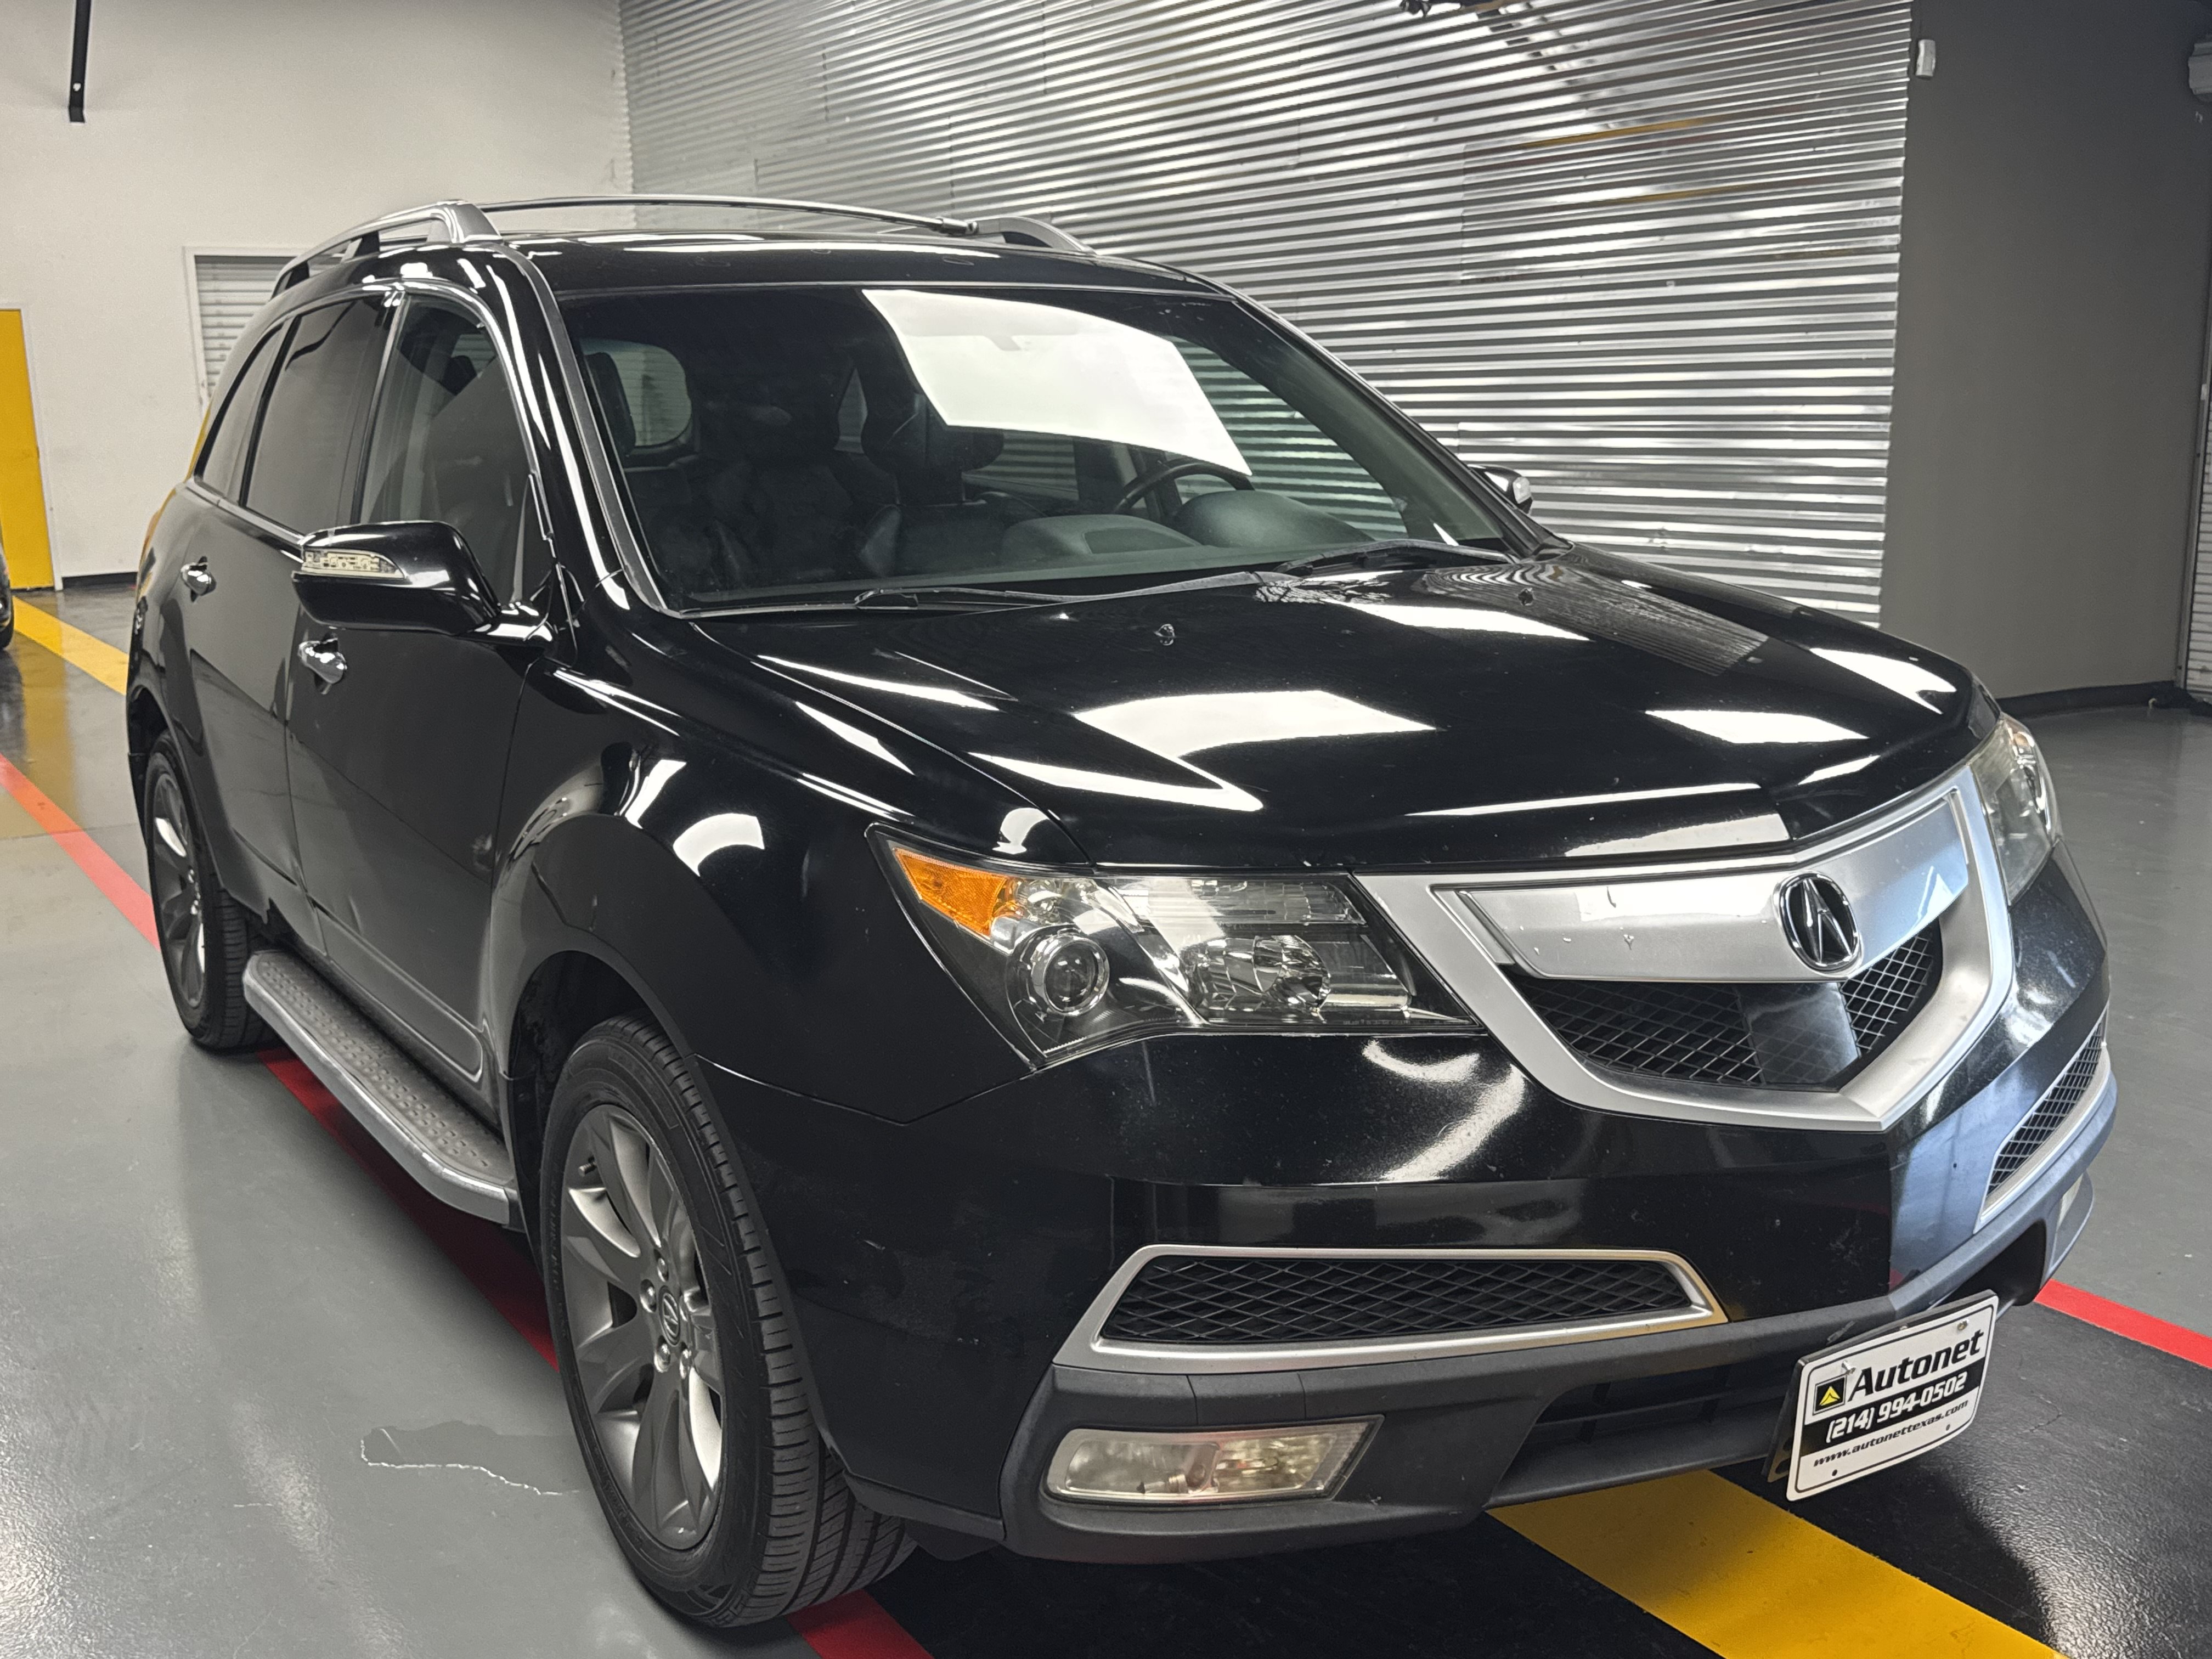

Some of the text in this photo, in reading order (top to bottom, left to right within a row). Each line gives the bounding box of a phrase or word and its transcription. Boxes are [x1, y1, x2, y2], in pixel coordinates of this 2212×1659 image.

[1847, 1329, 1984, 1402] Autonet
[1813, 1400, 1968, 1467] www.autonettexas.com
[1825, 1371, 1968, 1443] (214) 994-0502
